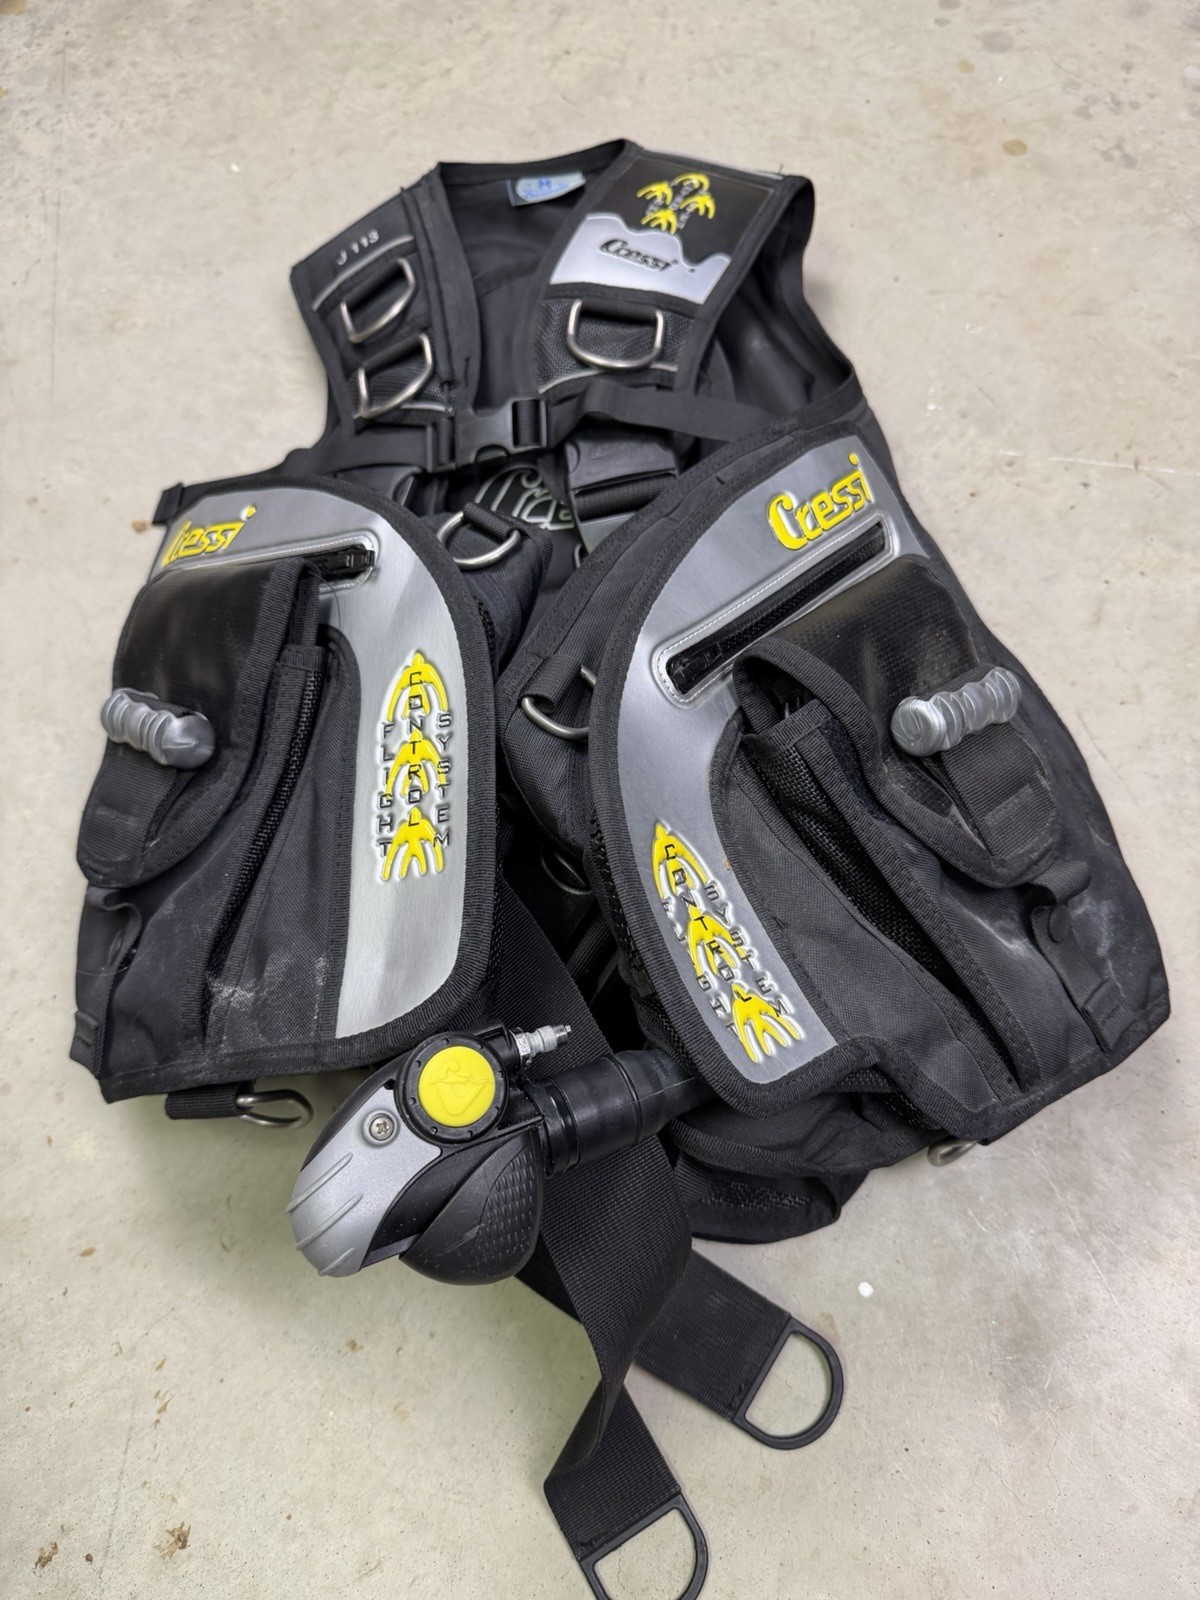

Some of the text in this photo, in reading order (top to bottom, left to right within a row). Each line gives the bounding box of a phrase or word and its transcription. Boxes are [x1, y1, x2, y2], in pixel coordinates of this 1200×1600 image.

[600, 239, 678, 272] Cressi
[768, 453, 871, 550] Cressi
[378, 723, 395, 857] FLIGHT
[408, 671, 423, 827] CONTROL
[433, 713, 452, 848] SYSTEM
[661, 902, 739, 1041] FLGHT
[664, 844, 752, 1002] CONTROL
[704, 884, 789, 1016] SYSTEM
